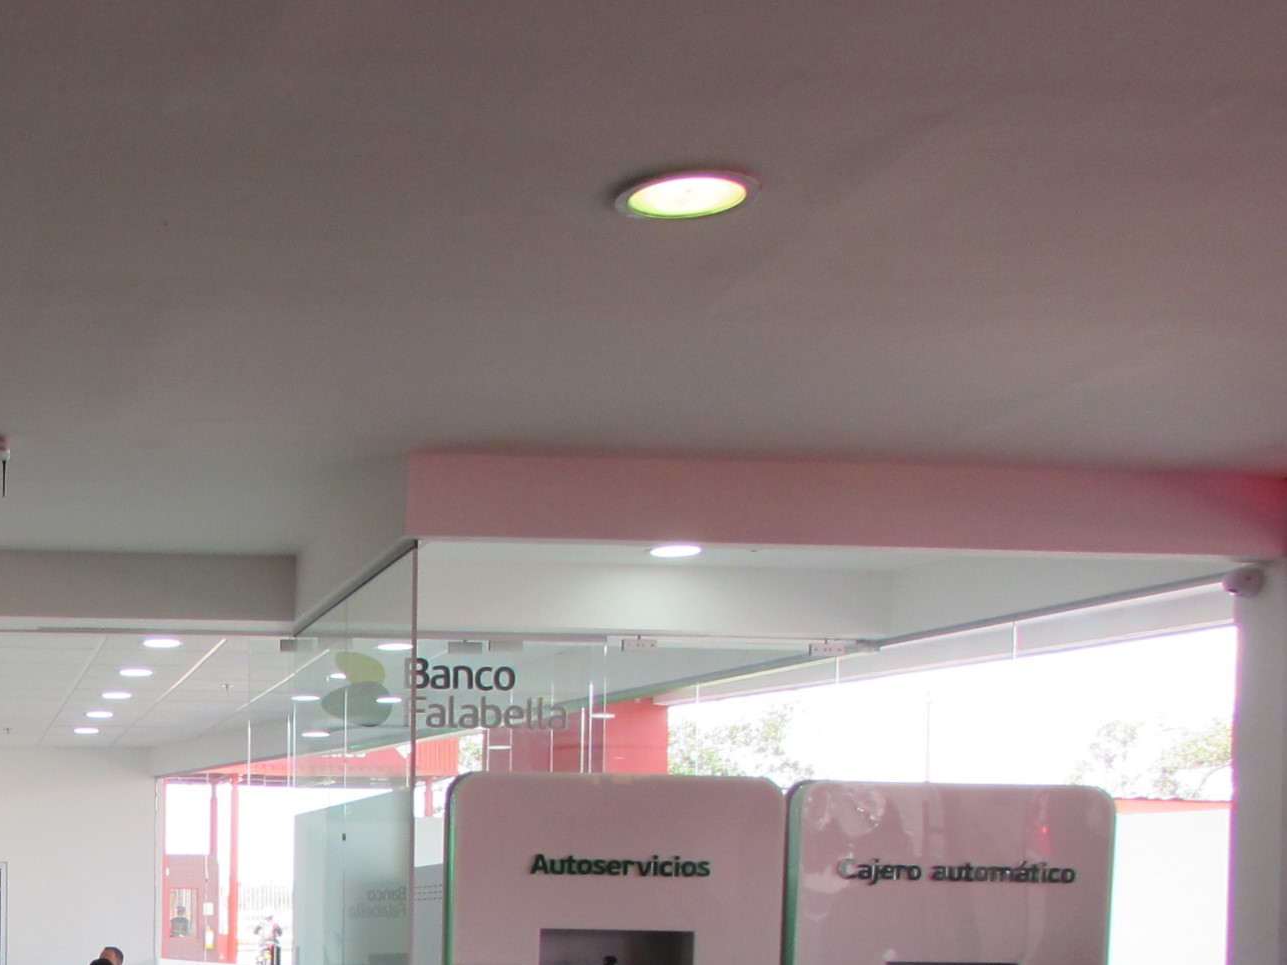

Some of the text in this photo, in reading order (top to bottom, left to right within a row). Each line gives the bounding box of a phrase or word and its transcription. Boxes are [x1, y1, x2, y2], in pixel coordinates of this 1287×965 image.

[404, 657, 515, 692] Banco
[404, 696, 568, 730] Falabella
[530, 854, 711, 878] Autoservicios
[838, 858, 1076, 886] Cajero automático
